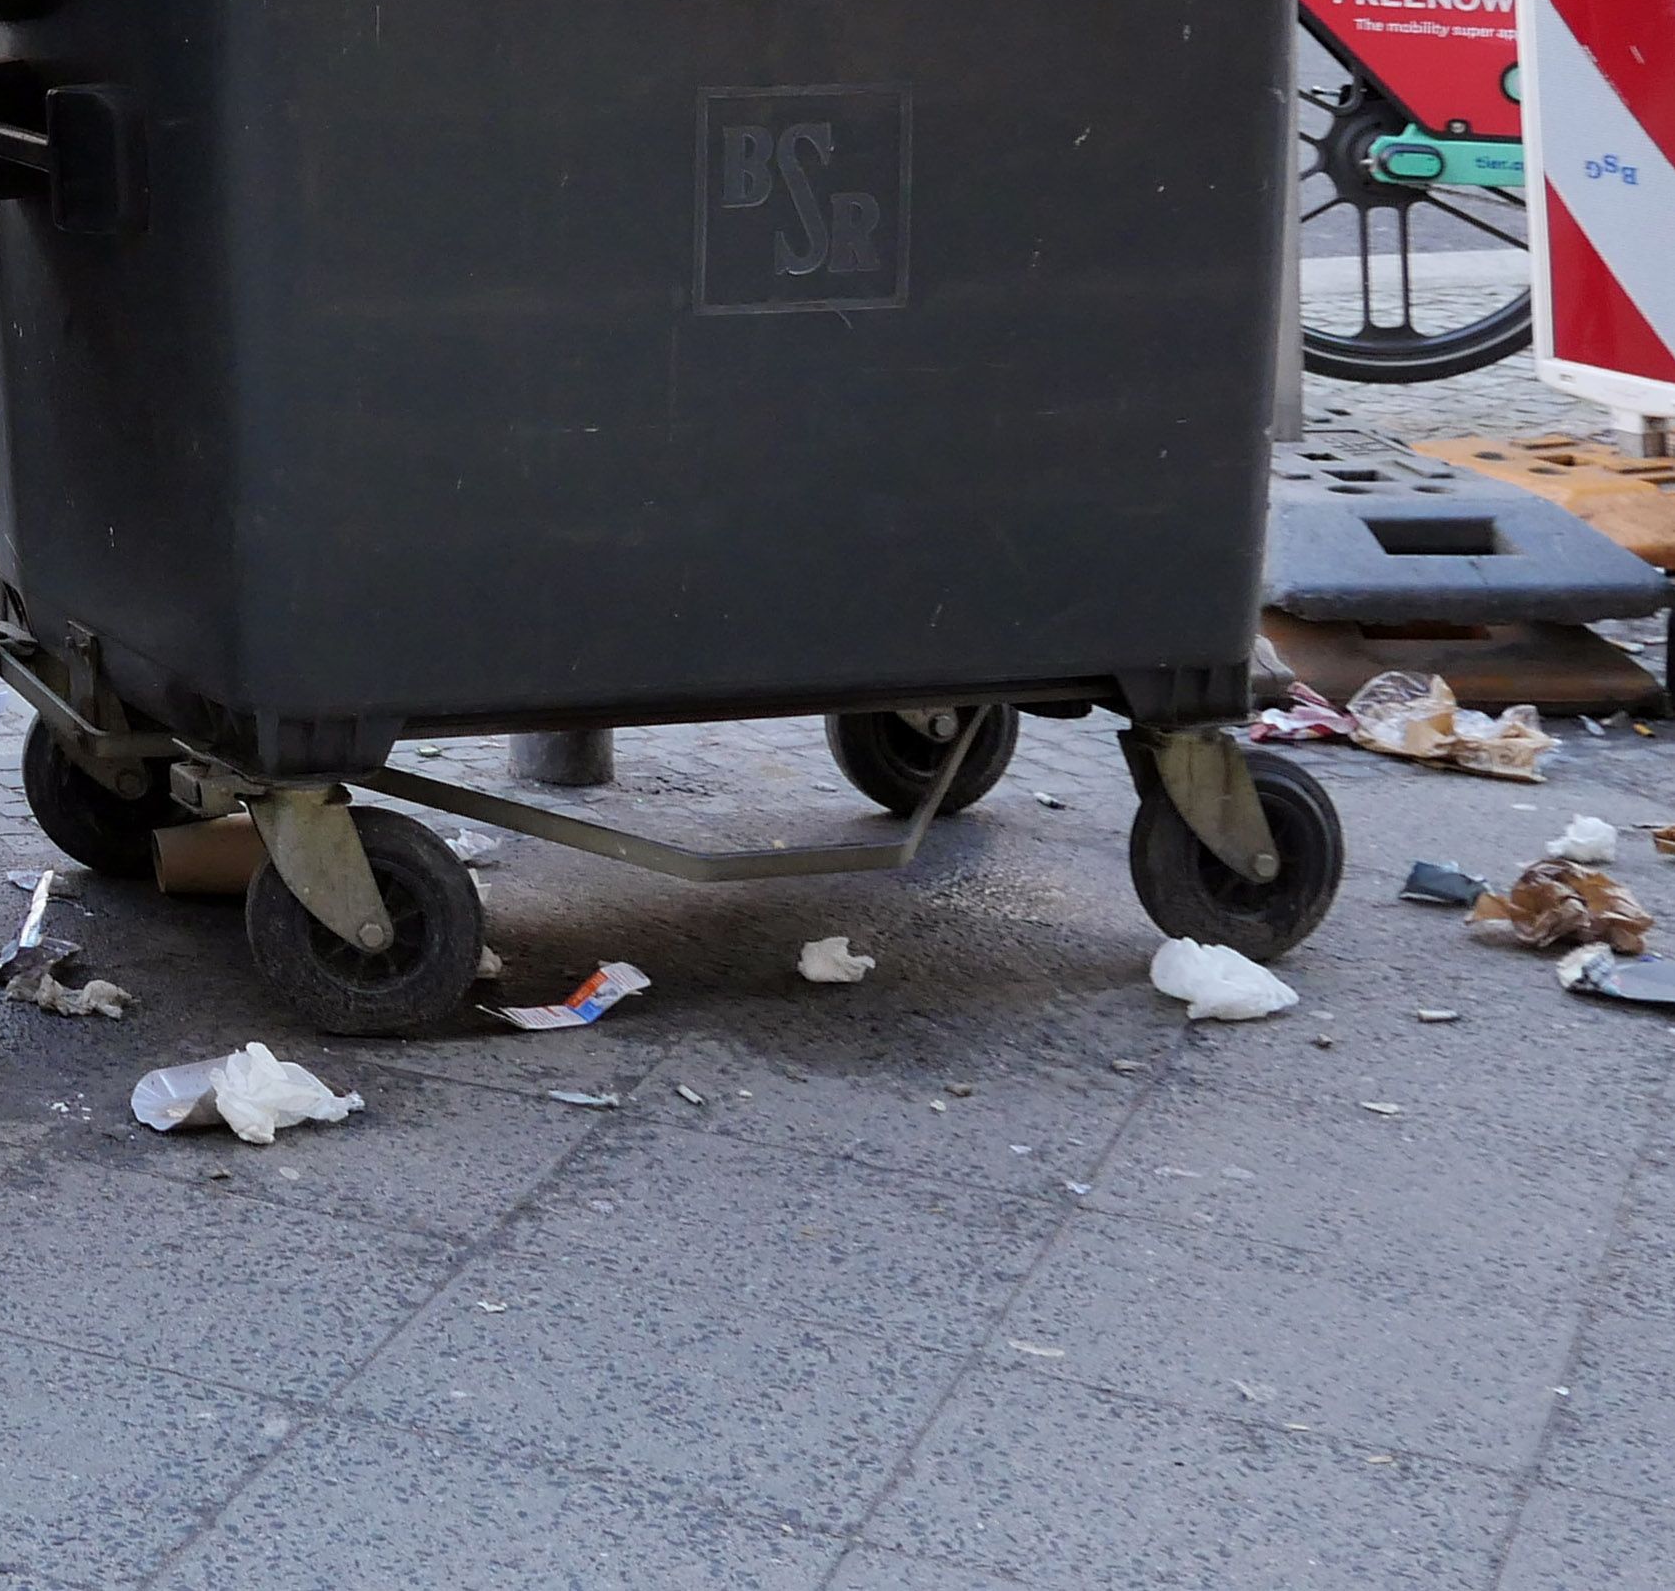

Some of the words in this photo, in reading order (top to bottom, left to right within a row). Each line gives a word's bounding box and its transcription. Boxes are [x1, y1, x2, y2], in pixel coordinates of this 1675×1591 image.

[1353, 17, 1385, 32] The
[1386, 19, 1450, 38] mobility
[1451, 25, 1495, 40] super
[720, 121, 882, 276] BSR
